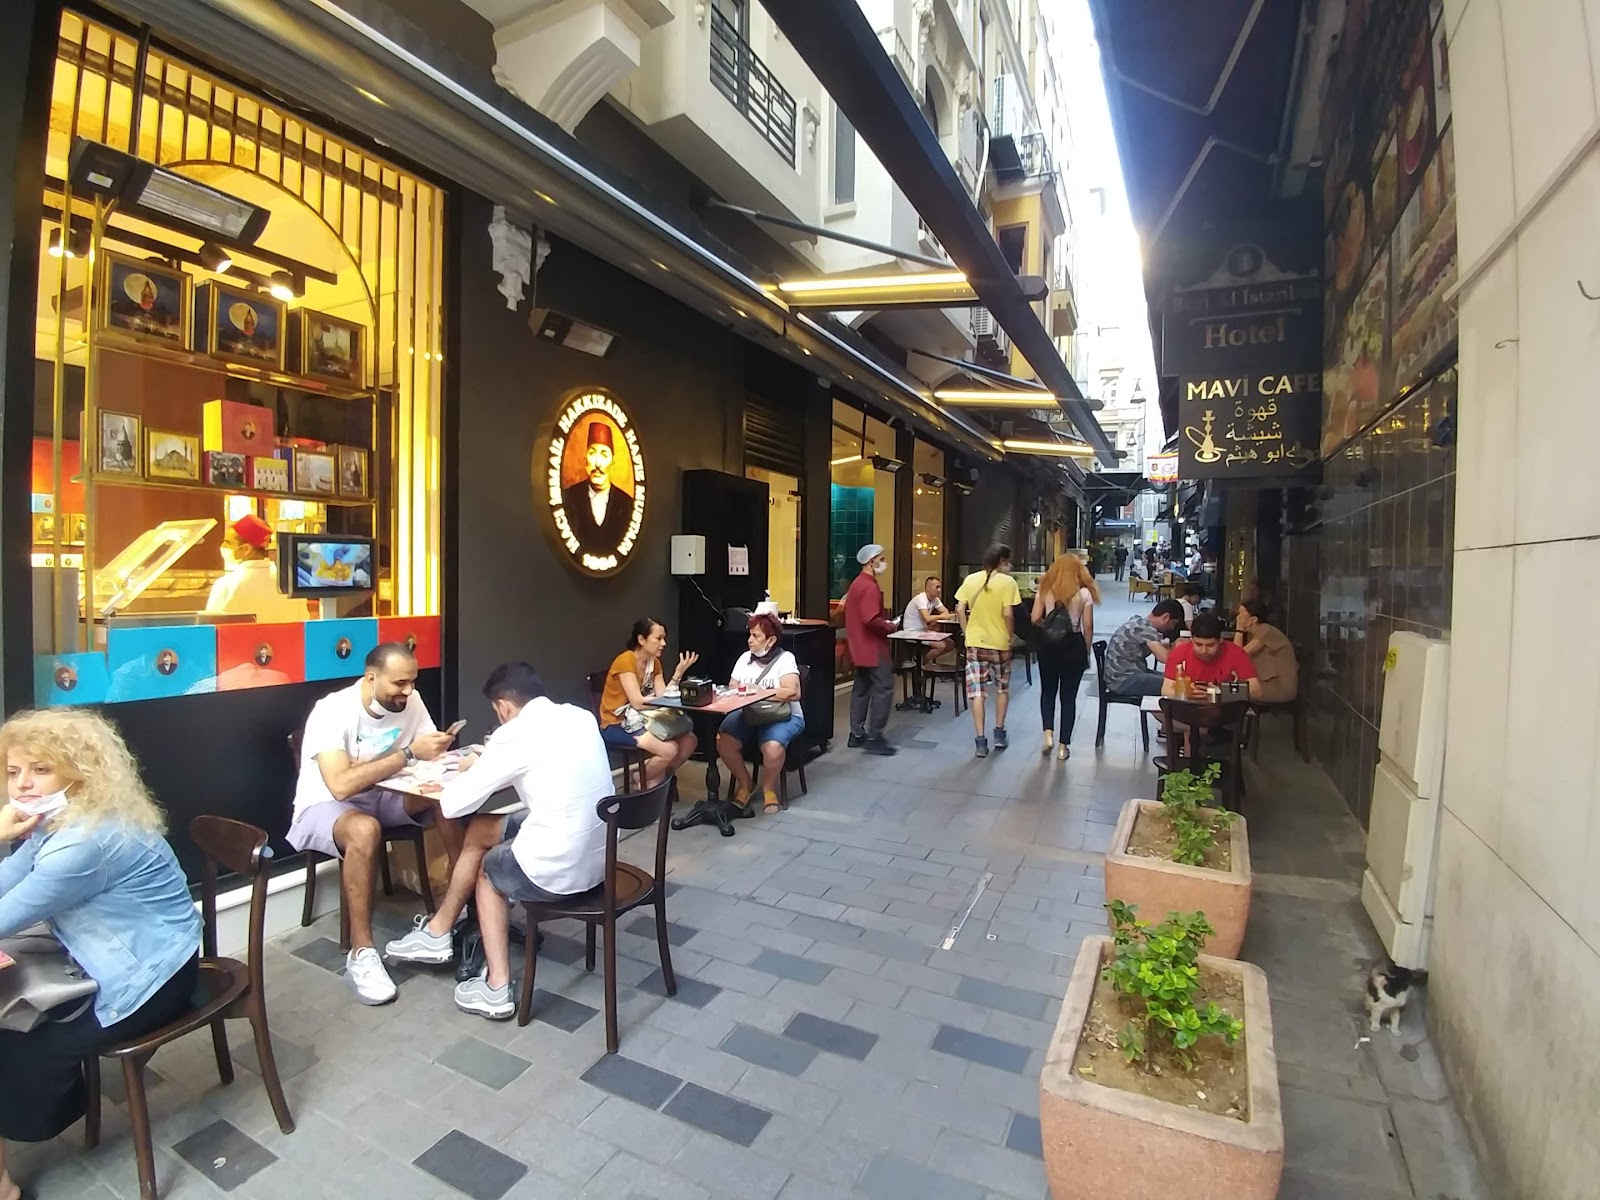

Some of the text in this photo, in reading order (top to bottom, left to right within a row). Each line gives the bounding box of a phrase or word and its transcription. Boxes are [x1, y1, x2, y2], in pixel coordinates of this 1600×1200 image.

[1203, 317, 1286, 348] Hotel
[1257, 373, 1320, 396] CAFE
[1234, 398, 1278, 422] قهوة
[1225, 421, 1283, 445] شيشة
[1225, 444, 1258, 468] هيثم
